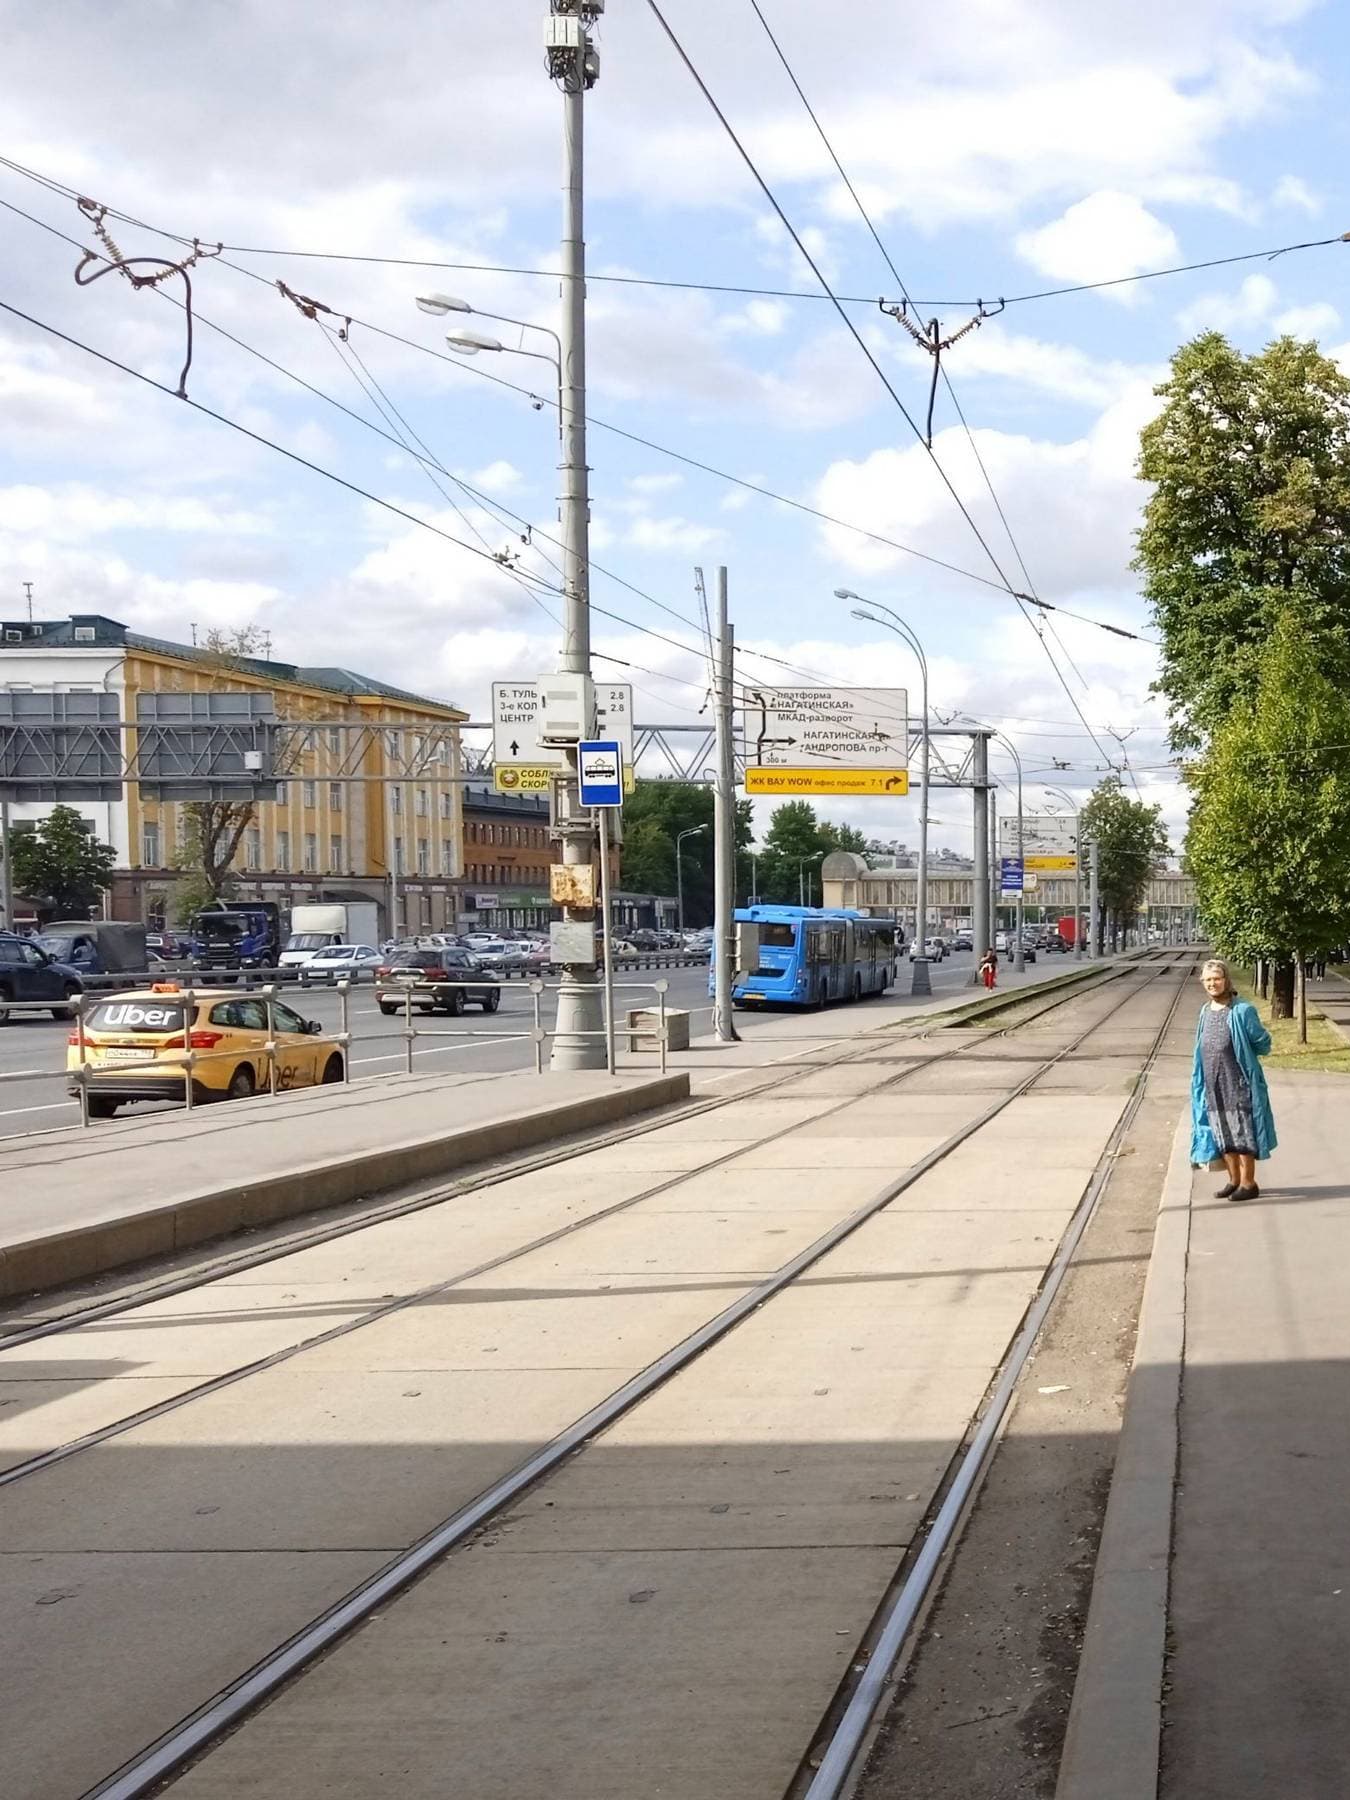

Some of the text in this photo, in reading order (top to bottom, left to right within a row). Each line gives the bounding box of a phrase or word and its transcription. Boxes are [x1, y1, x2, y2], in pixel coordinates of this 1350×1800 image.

[499, 689, 538, 698] Б. ТУЛЬ
[610, 691, 625, 700] 2.8
[777, 691, 832, 701] платформа
[500, 702, 538, 711] 3-е КОЛ
[610, 703, 625, 712] 2.8
[500, 714, 534, 723] ЦЕНТР
[777, 713, 853, 722] МКАД-разворот
[803, 731, 875, 740] НАГАТИНСКАЯ
[804, 743, 889, 753] АНДРОПОВА пр-т
[520, 769, 549, 778] СОБЛ
[520, 779, 548, 788] СКОР
[750, 777, 766, 785] ЖК
[767, 777, 785, 785] ВАУ
[786, 778, 812, 786] WOW
[103, 1005, 177, 1026] Uber
